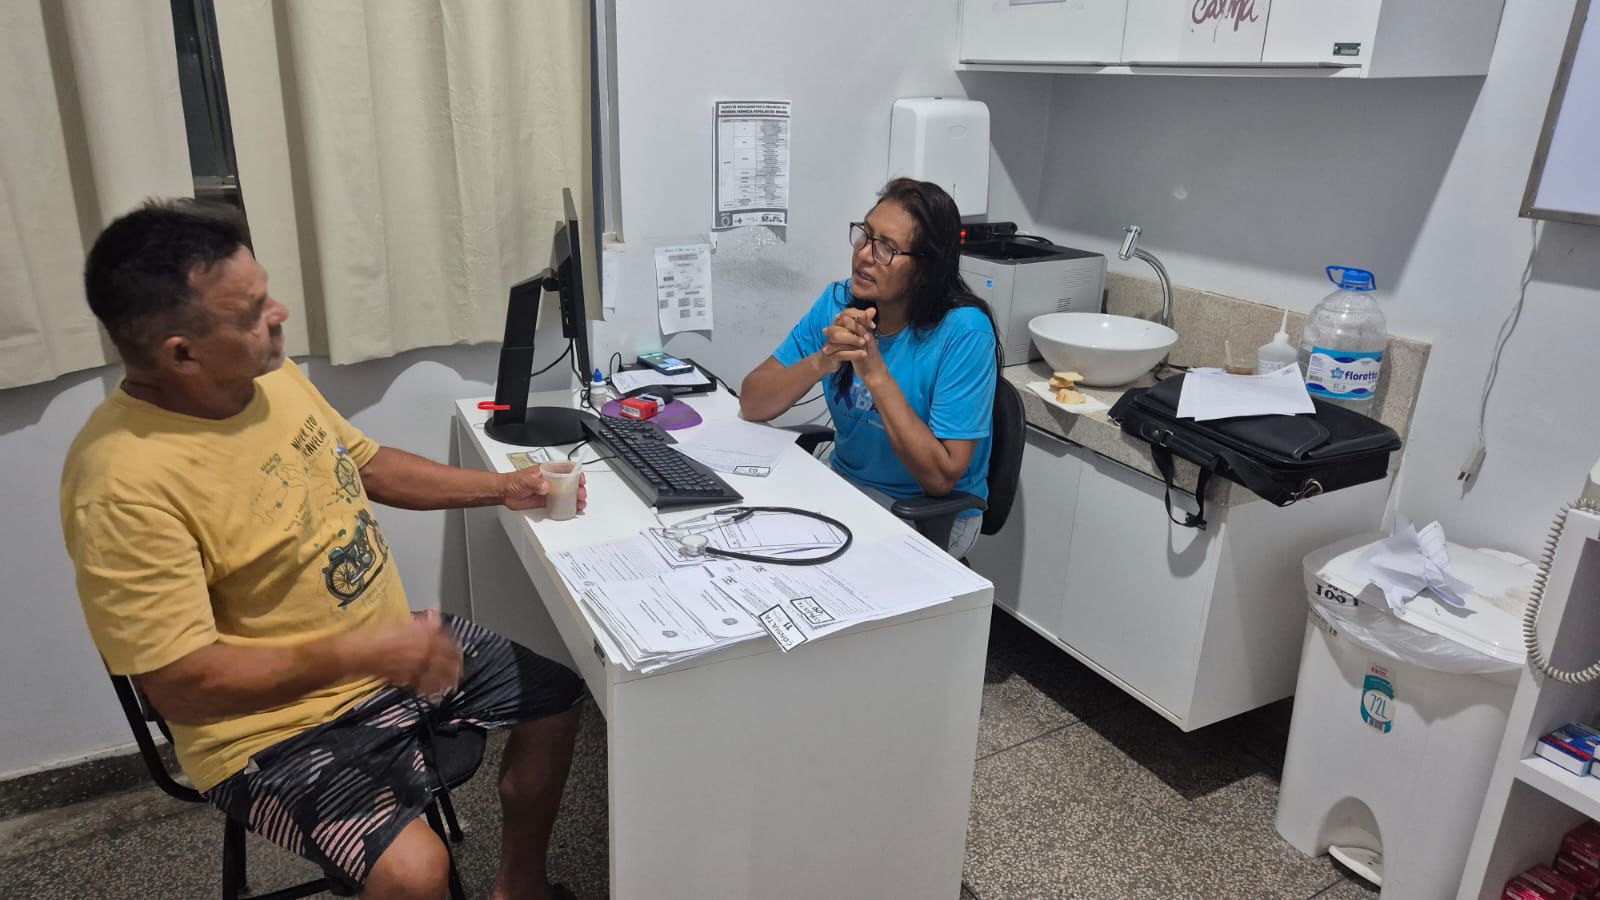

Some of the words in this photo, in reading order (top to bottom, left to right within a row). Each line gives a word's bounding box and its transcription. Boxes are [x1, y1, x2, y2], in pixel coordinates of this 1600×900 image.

[765, 613, 793, 646] CONSULTA
[783, 621, 793, 631] 11
[1370, 693, 1388, 720] 72L
